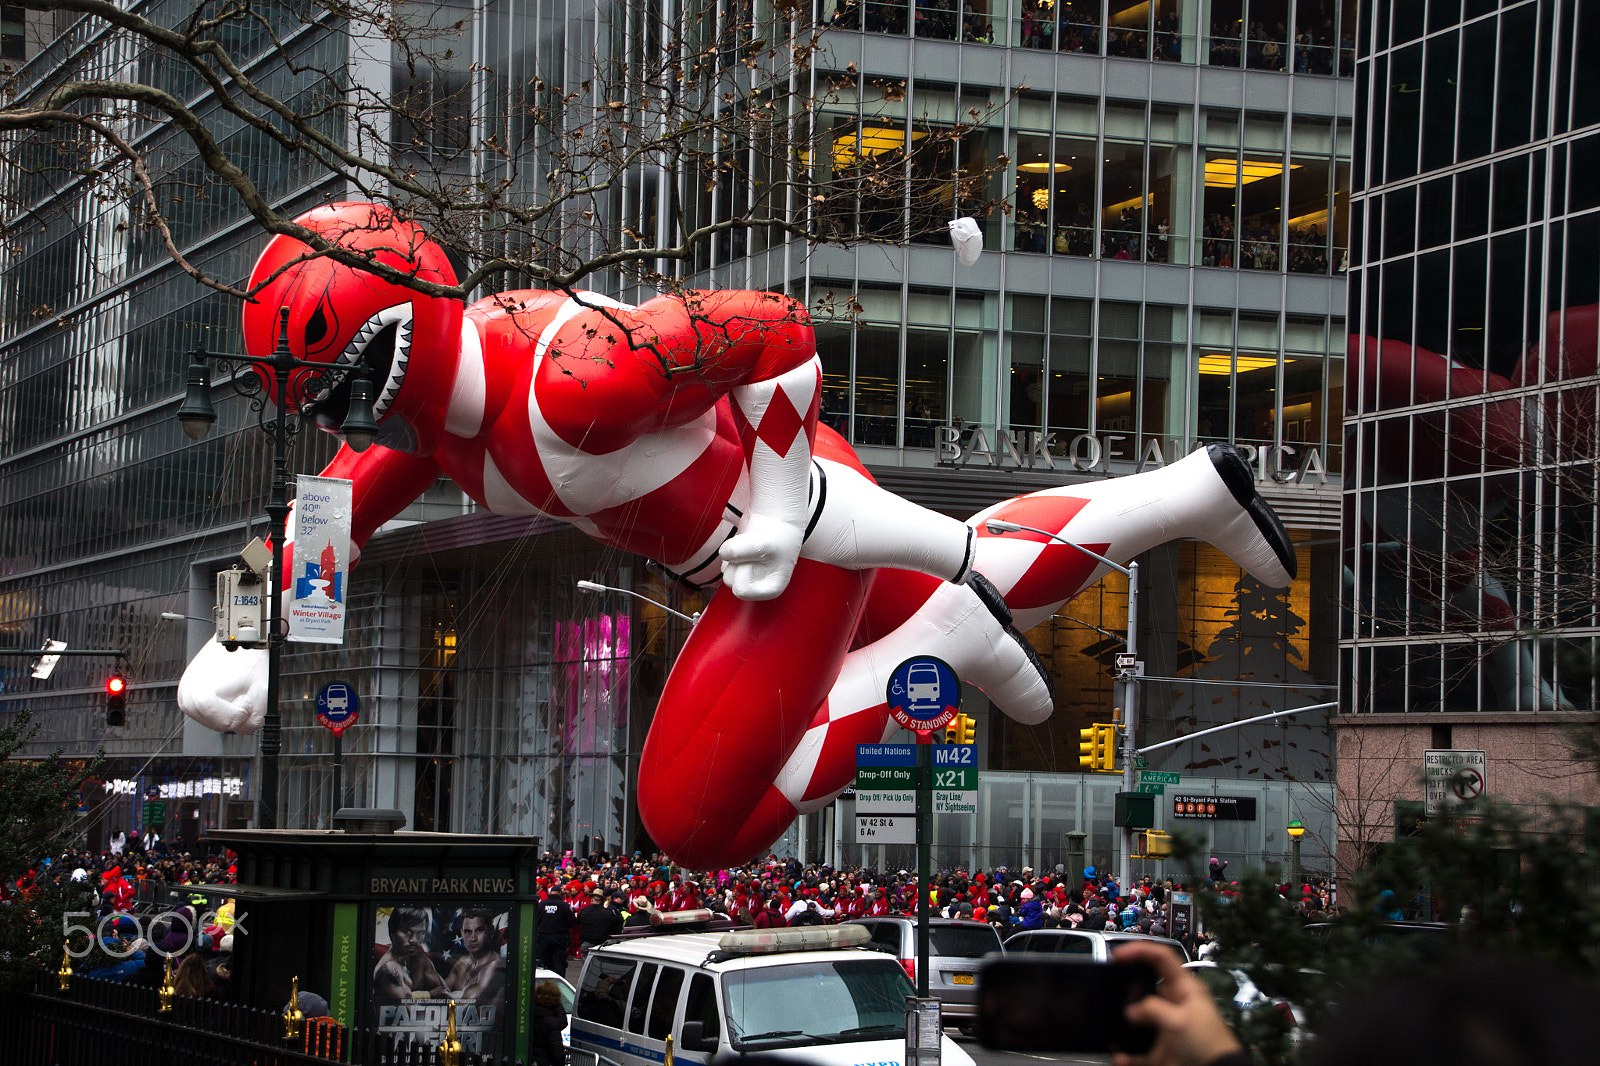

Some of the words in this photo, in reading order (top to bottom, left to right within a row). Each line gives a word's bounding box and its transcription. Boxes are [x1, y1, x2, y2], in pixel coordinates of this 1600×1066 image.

[935, 425, 1057, 470] BANK
[1069, 433, 1126, 474] OF
[302, 492, 330, 502] above
[302, 503, 320, 512] 40th
[302, 514, 328, 525] below
[234, 596, 258, 606] 7-1643
[318, 611, 341, 620] Village
[320, 716, 328, 724] NO
[328, 714, 356, 728] STANDING
[896, 710, 909, 724] NO
[910, 711, 953, 730] STANDING
[860, 747, 882, 755] United
[884, 747, 910, 755] Nations
[936, 747, 971, 763] M42
[1427, 755, 1463, 764] RESTRICTED
[1467, 756, 1483, 764] AREA
[859, 770, 892, 780] Drop-Off
[894, 770, 910, 780] Only
[1428, 768, 1453, 776] TRUCKS
[1143, 775, 1177, 784] AMERICAS
[1145, 785, 1151, 793] 6
[860, 794, 871, 802] Drop
[895, 794, 901, 802] Up
[902, 794, 914, 802] Only
[936, 792, 948, 802] Gray
[950, 792, 963, 800] Line/
[936, 803, 943, 811] NY
[945, 802, 975, 813] Sightseeing
[371, 878, 428, 893] BRYANT
[432, 878, 469, 893] PARK
[473, 878, 514, 893] NEWS
[340, 935, 349, 972] PARK
[339, 978, 348, 1026] RYANT
[380, 1004, 496, 1028] PACQUIAO
